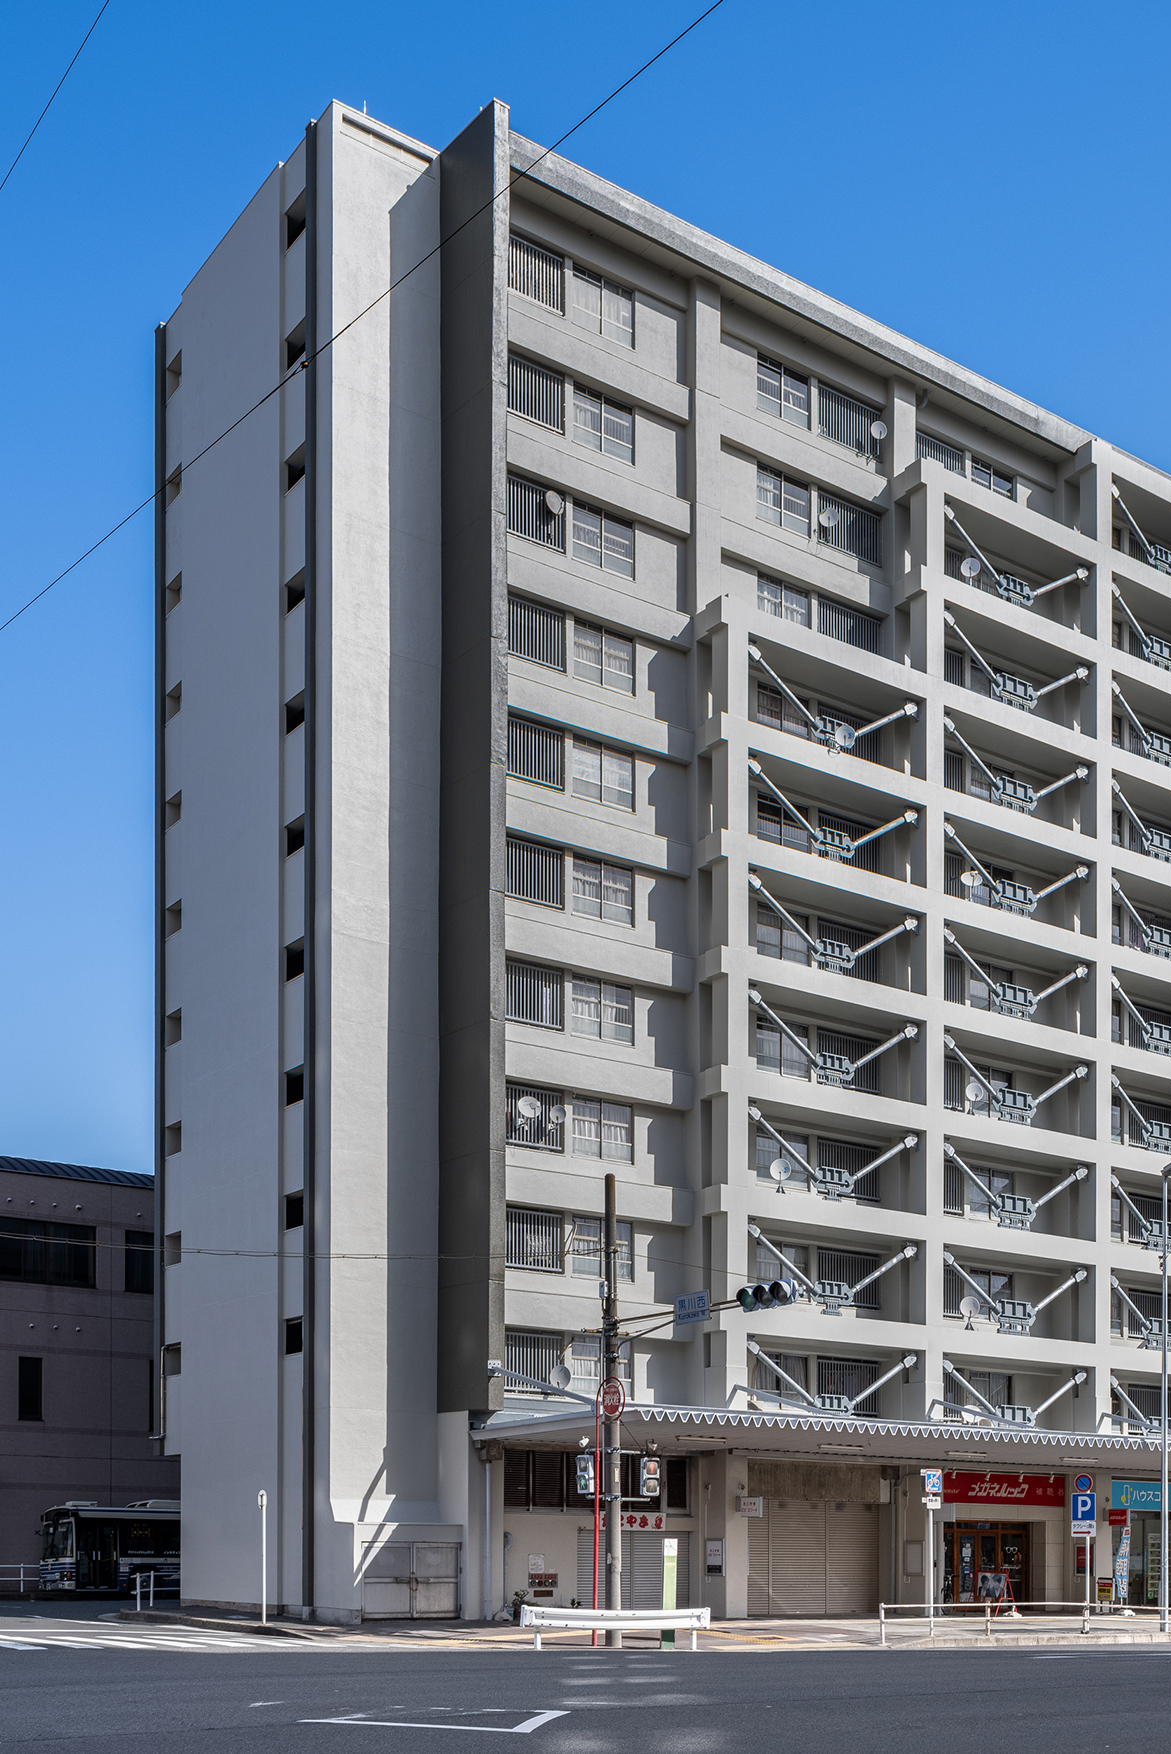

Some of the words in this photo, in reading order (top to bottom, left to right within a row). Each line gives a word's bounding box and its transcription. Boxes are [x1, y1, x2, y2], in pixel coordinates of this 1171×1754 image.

[678, 1295, 706, 1312] 黒川西
[968, 1481, 1029, 1498] メガネルック
[1132, 1489, 1162, 1502] ハウスコ
[1077, 1496, 1092, 1519] P
